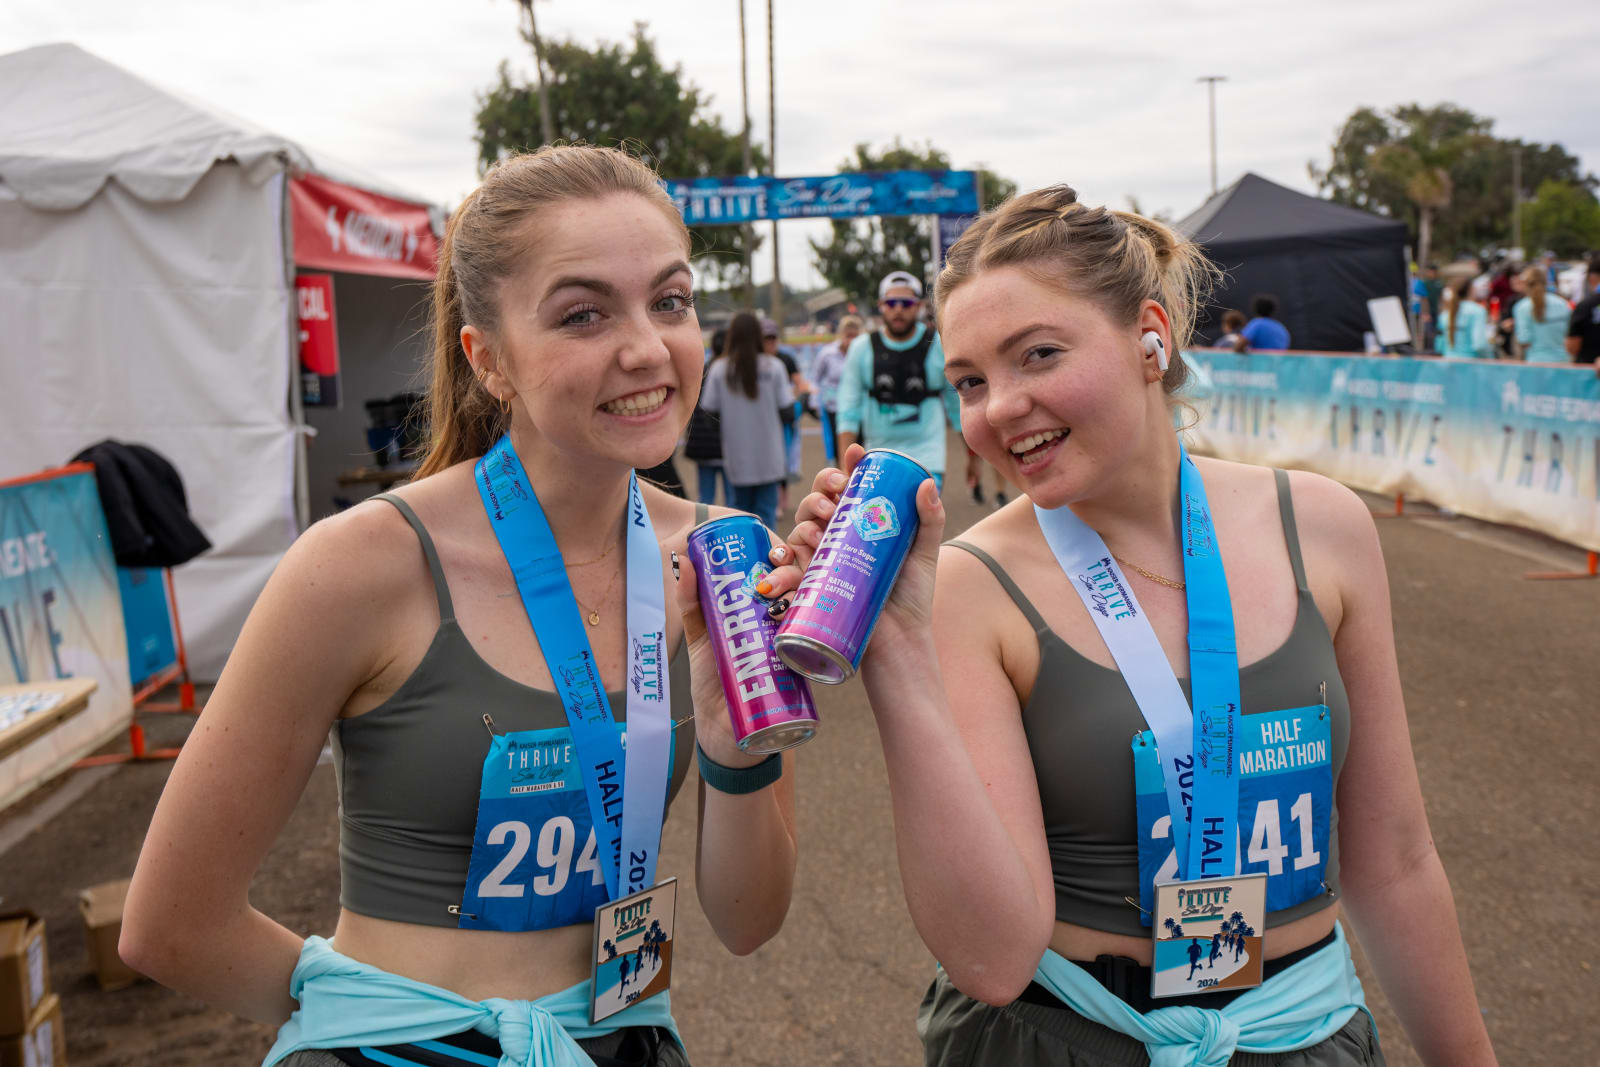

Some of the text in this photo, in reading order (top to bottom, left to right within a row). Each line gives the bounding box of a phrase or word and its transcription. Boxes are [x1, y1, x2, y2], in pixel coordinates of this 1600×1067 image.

[843, 544, 877, 564] Zero Sugar
[824, 584, 855, 602] CAFFEINE
[828, 576, 857, 593] NATURAL
[1087, 561, 1131, 621] THRIVE
[711, 571, 776, 703] ENERGY
[642, 632, 657, 701] THRIVE
[1260, 718, 1302, 745] HALF
[508, 745, 571, 770] THRIVE
[1239, 739, 1326, 775] MARATHON
[1178, 890, 1230, 908] THRIVE
[1197, 978, 1218, 988] 2024
